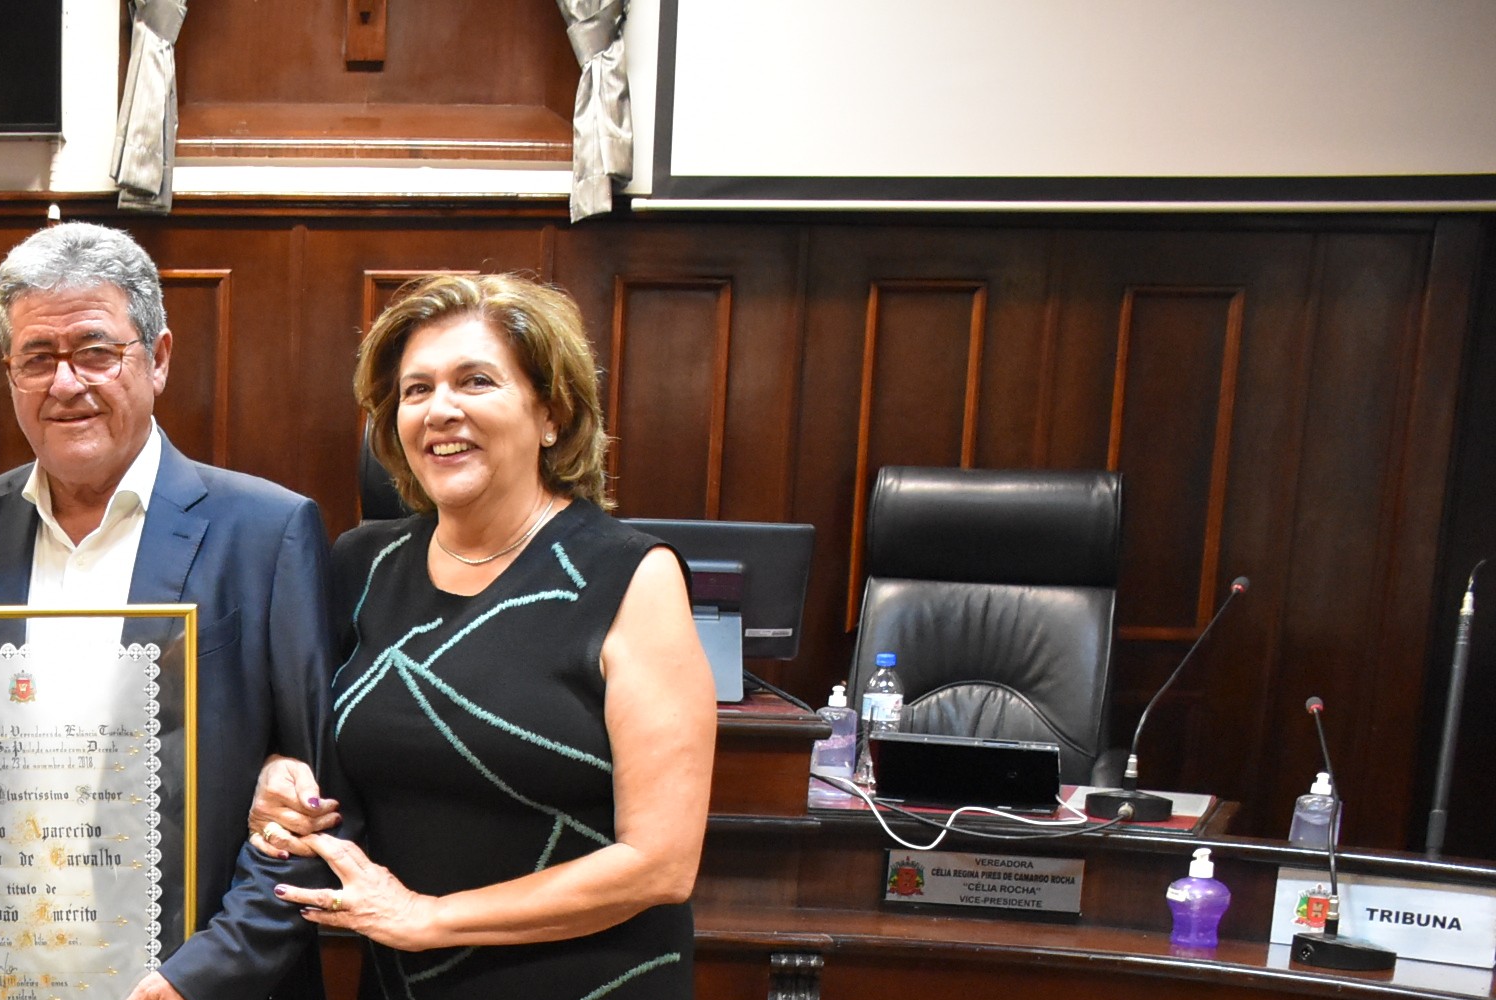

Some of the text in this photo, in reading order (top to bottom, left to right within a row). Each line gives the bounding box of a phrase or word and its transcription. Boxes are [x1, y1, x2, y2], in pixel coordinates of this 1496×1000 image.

[75, 784, 123, 804] Senhor
[25, 817, 102, 841] Aparecido
[19, 851, 35, 867] de
[50, 848, 122, 869] Carvalho
[975, 857, 1034, 869] VEREADORA
[931, 867, 1076, 885] CÉLIA REGINA PIRES DE CAMARGO ROCHA
[46, 883, 57, 895] de
[959, 895, 1043, 908] VICE-PRESIDENTE
[1365, 907, 1463, 931] TRIBUNA
